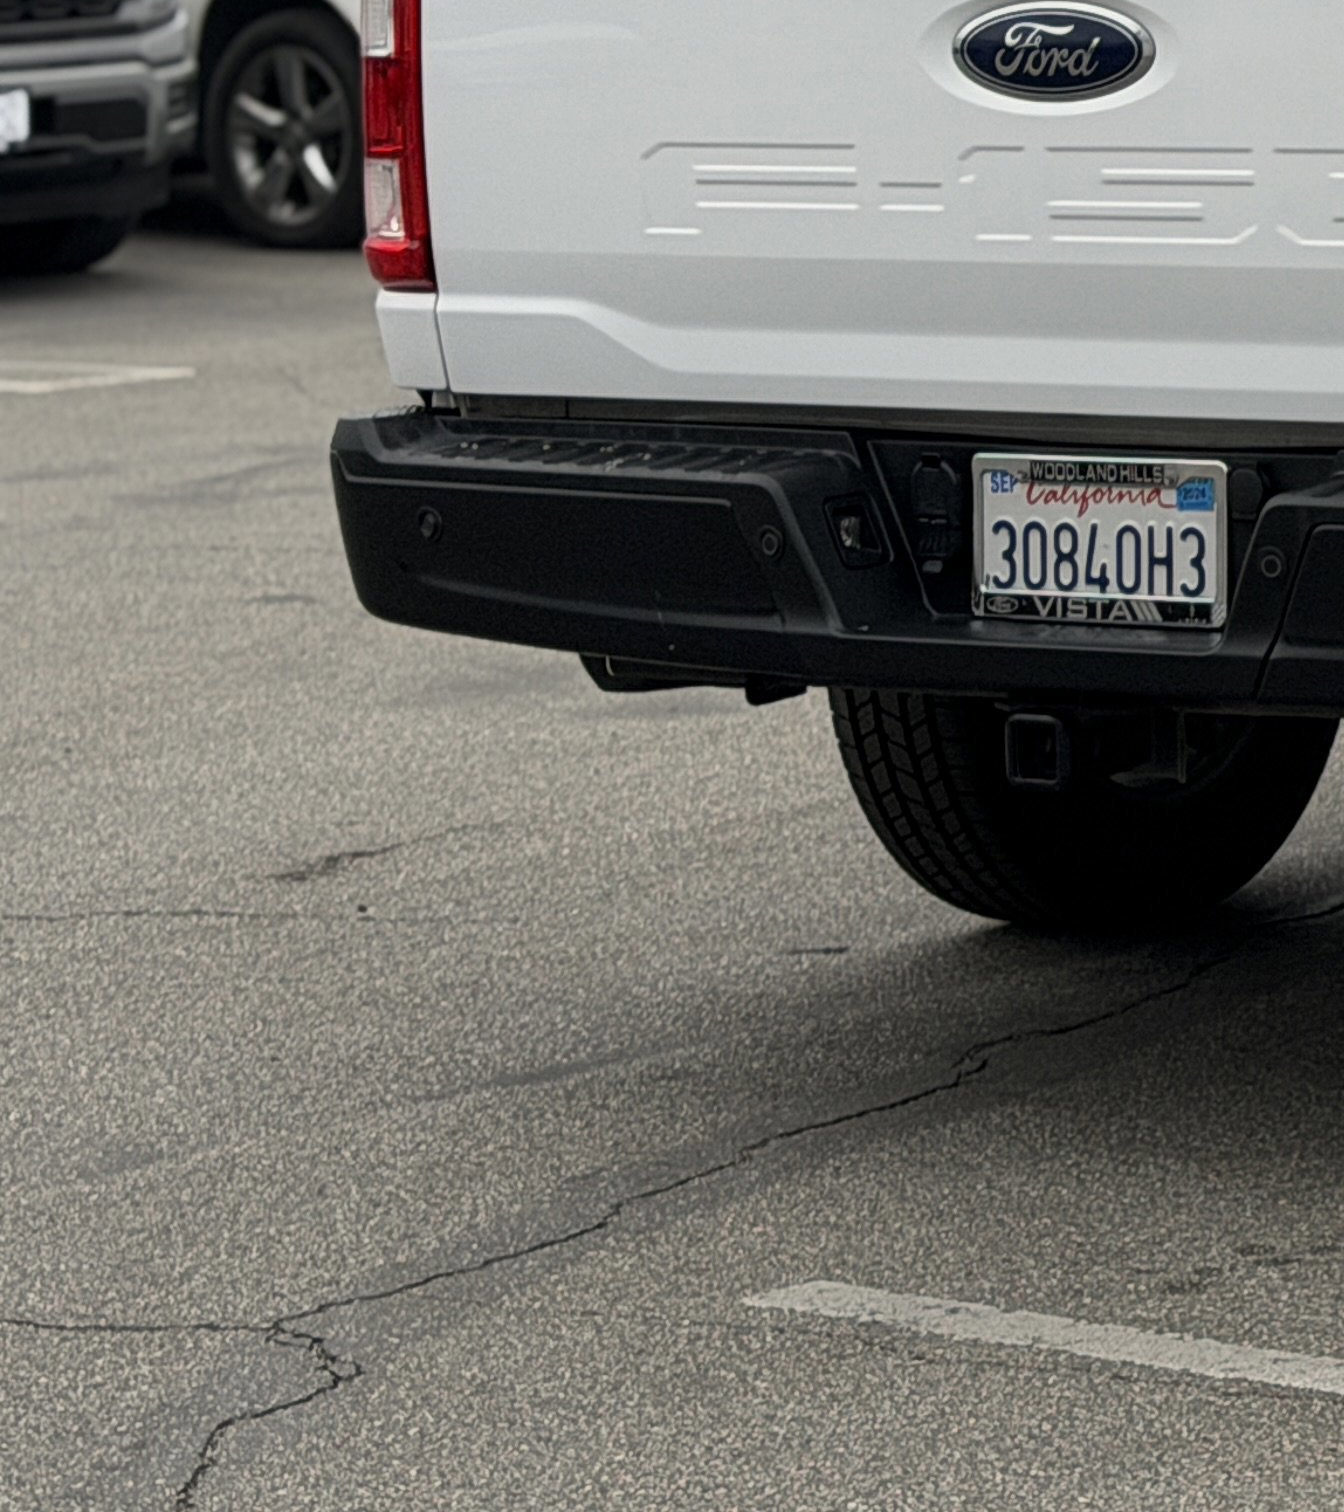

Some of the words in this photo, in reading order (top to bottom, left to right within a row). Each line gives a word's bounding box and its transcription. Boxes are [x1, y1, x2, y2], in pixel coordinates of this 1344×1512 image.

[995, 21, 1101, 77] Ford
[1031, 462, 1117, 483] WOODLAND
[1120, 465, 1164, 484] HILLS
[1026, 479, 1177, 518] California
[991, 519, 1206, 598] 30840H3
[1032, 596, 1134, 622] VISTA
